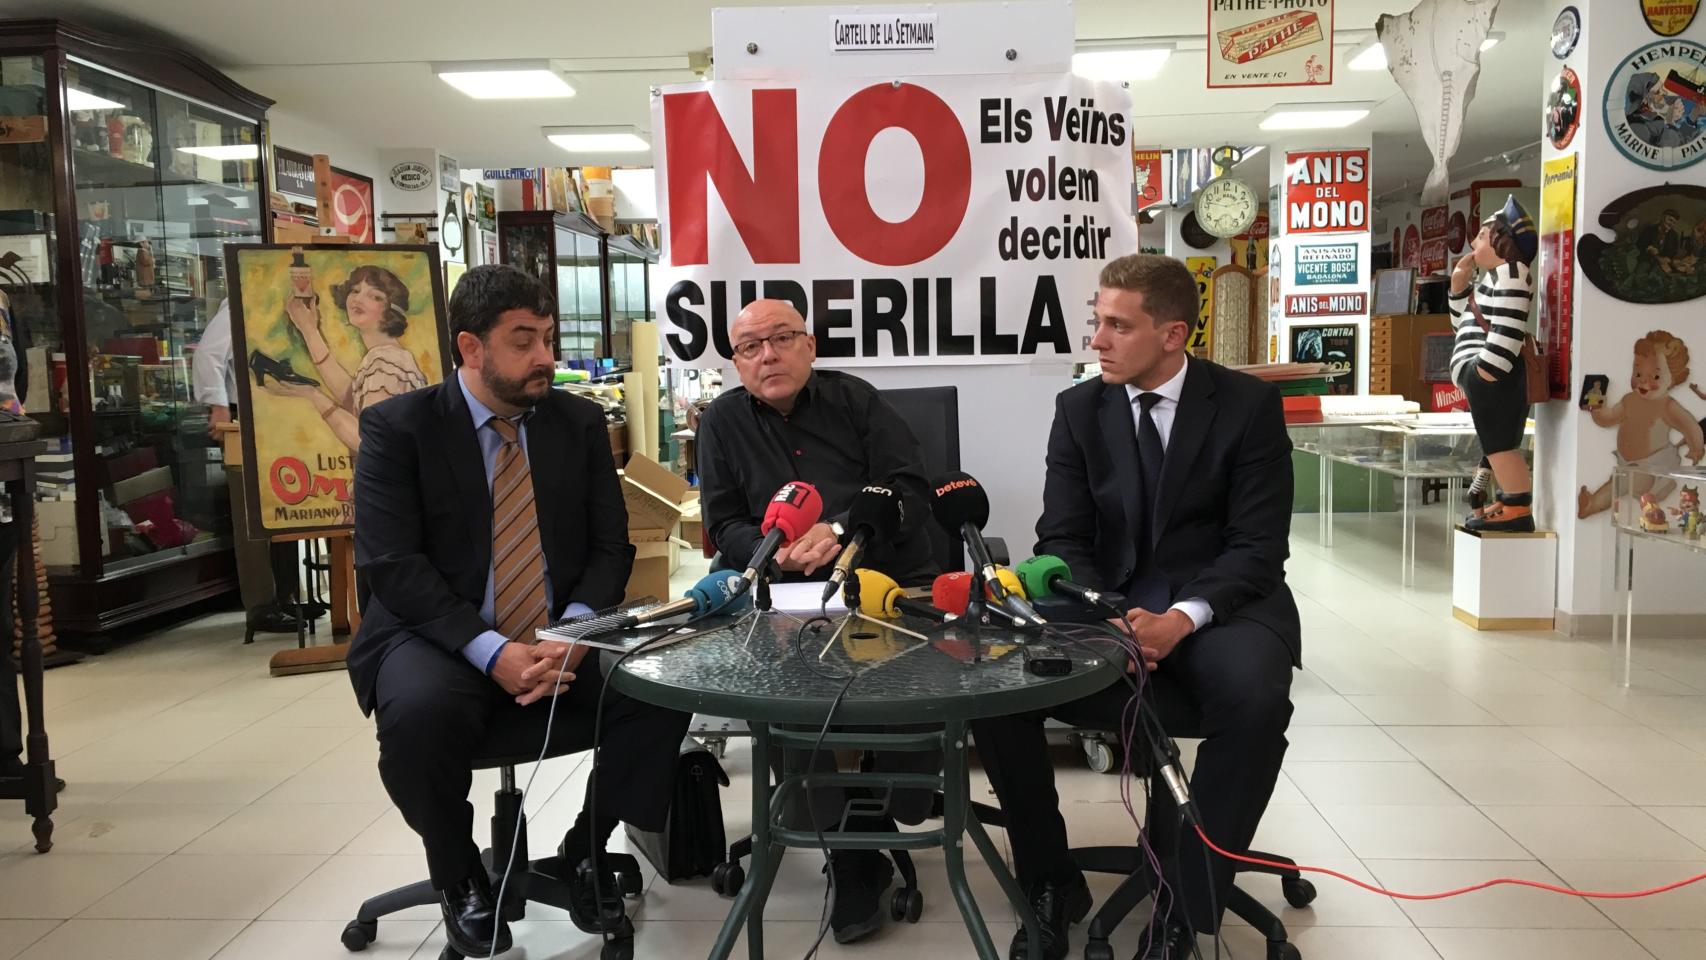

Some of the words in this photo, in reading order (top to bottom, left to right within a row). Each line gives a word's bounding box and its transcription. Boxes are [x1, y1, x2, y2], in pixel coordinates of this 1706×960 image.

[1646, 5, 1694, 16] HARVESTER
[980, 98, 1033, 144] Els
[1044, 95, 1126, 147] Veïns
[1615, 122, 1661, 160] MARINE
[1681, 135, 1706, 158] PAI
[662, 82, 972, 267] NO
[1006, 155, 1099, 203] volem
[1315, 187, 1340, 198] DEL
[1290, 200, 1365, 229] MONO
[998, 214, 1112, 262] decidir
[1297, 263, 1328, 274] VICENTE
[1331, 262, 1356, 273] BOSCH
[1289, 296, 1318, 313] ANIS
[1329, 295, 1362, 312] MONO
[1321, 328, 1354, 337] CONTRA
[275, 505, 339, 521] MARIANO
